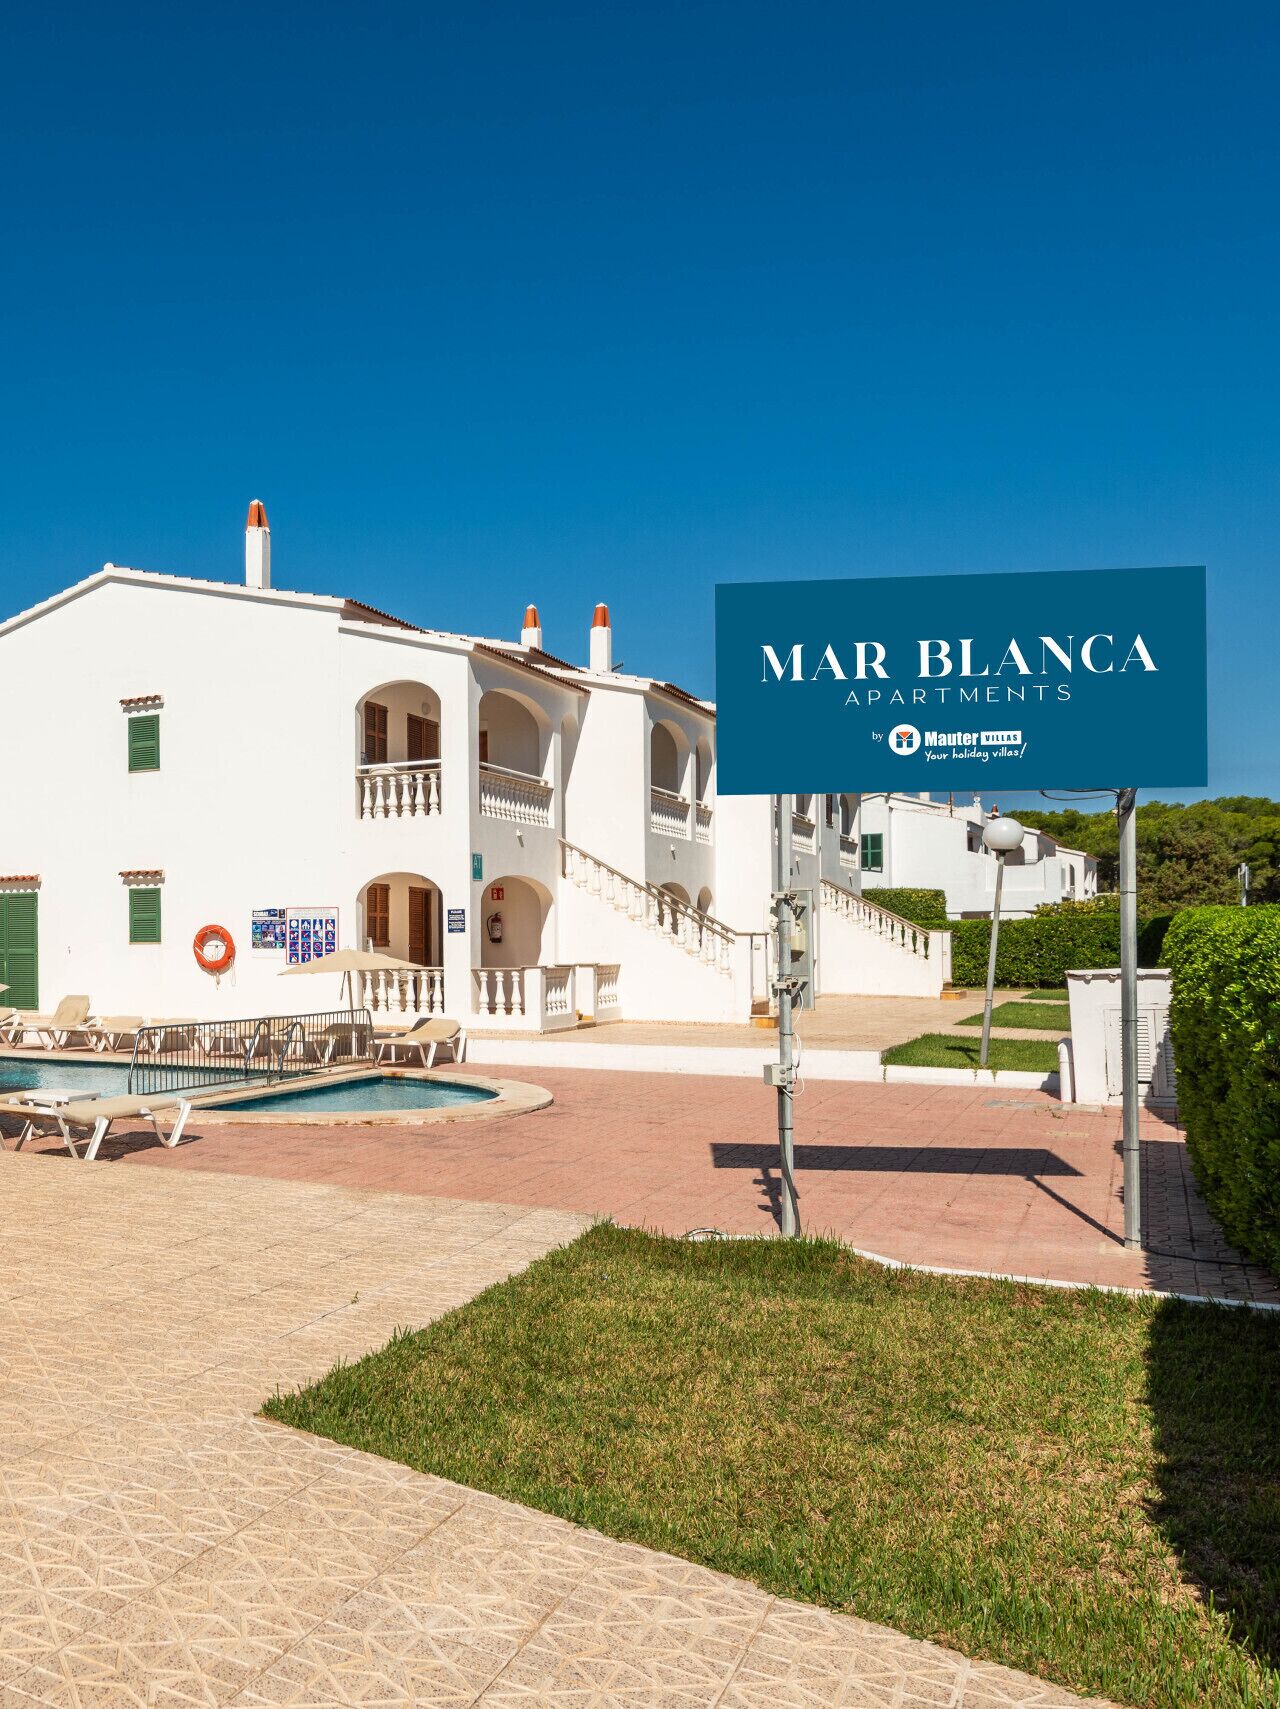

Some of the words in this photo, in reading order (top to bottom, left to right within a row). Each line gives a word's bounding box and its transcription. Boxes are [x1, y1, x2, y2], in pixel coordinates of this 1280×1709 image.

[760, 641, 891, 683] MAR
[916, 633, 1160, 678] BLANCA
[844, 684, 1071, 706] APARTMENTS
[872, 731, 884, 743] by
[924, 730, 979, 747] Mauter
[984, 733, 1019, 742] VILLAS
[924, 749, 949, 762] Your
[952, 746, 990, 763] holiday
[992, 742, 1028, 759] villas!
